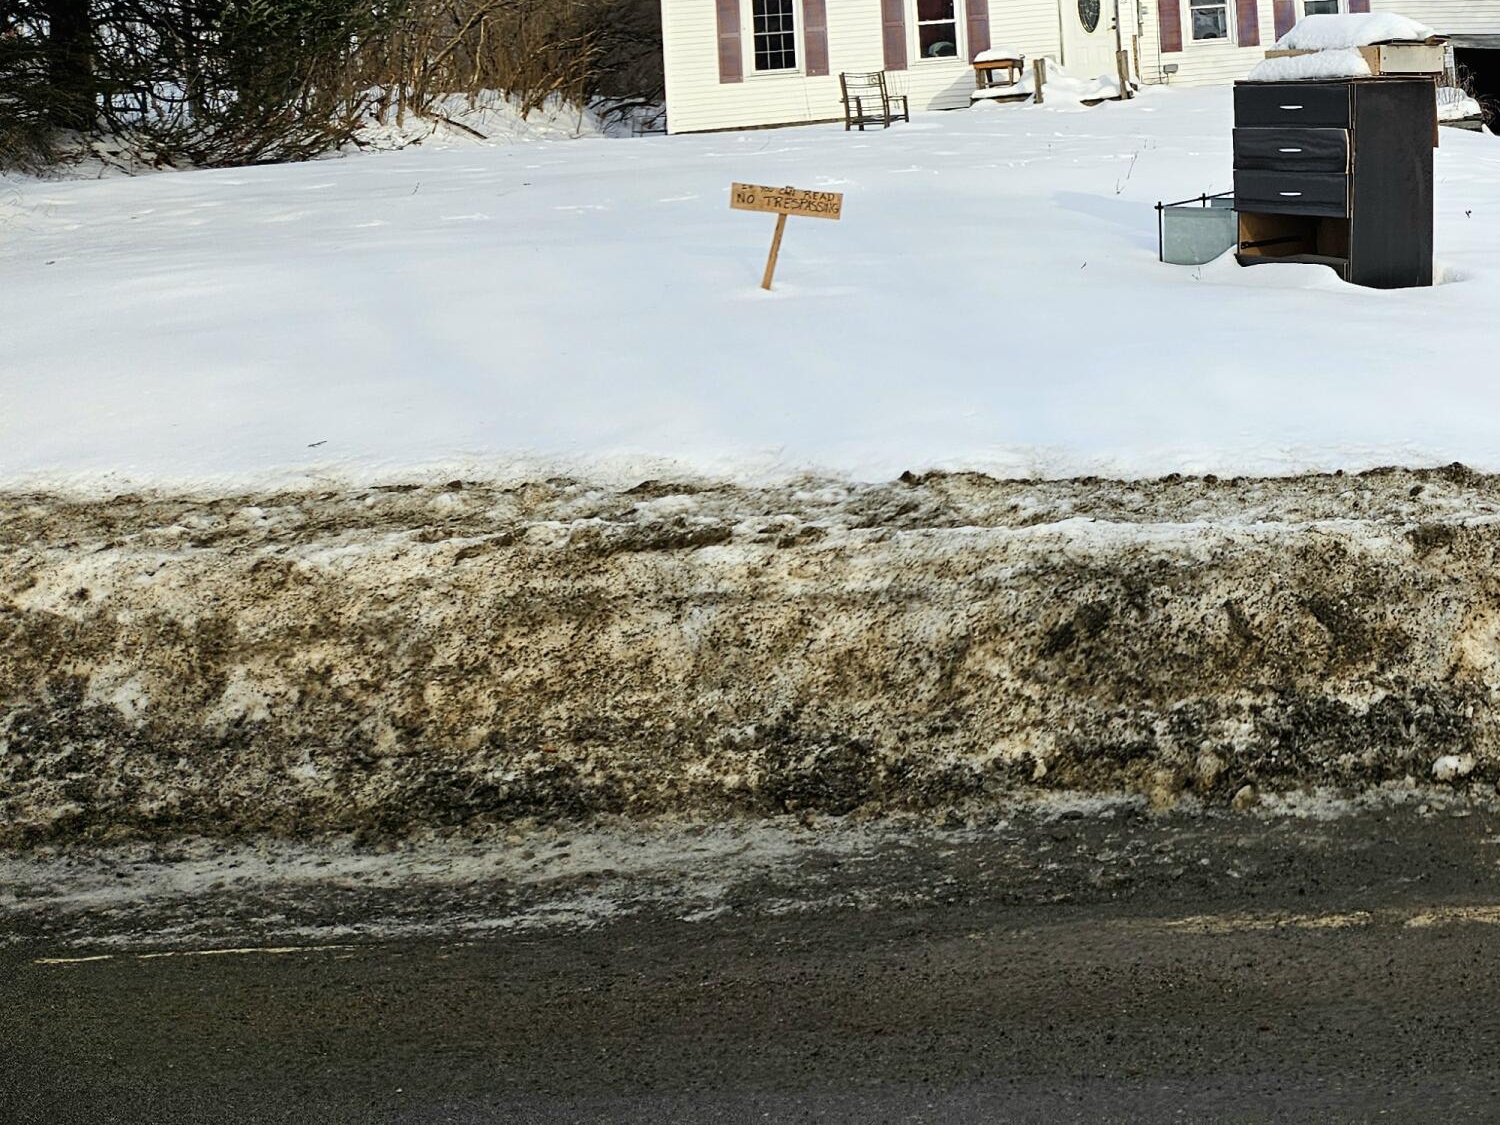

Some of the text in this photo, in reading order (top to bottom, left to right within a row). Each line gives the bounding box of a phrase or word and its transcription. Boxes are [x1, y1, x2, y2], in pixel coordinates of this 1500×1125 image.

[736, 193, 840, 214] NO TRESPASSING
[803, 190, 835, 202] READ
